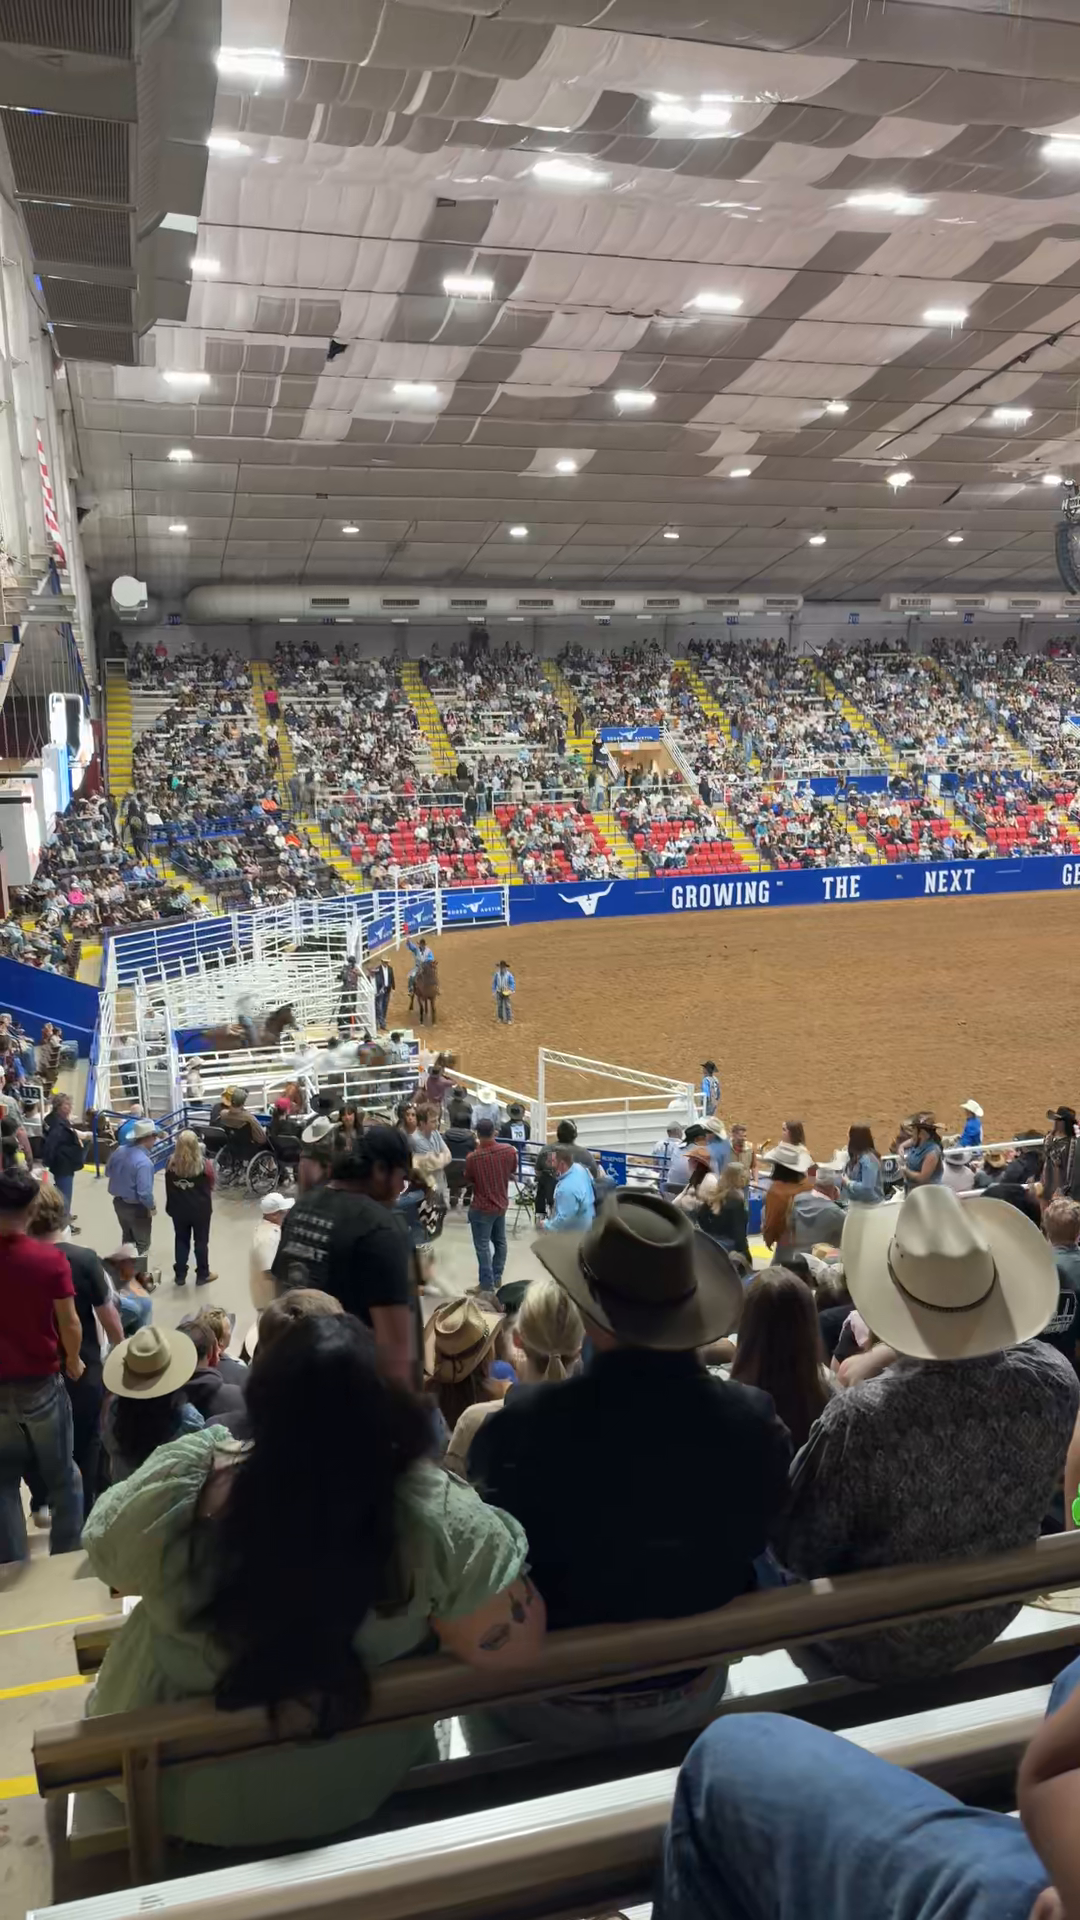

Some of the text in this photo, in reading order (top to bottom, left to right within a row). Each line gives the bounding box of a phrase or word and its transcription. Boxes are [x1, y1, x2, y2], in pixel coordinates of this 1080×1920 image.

[671, 880, 770, 909] GROWING
[822, 875, 861, 900] THE
[924, 869, 975, 893] NEXT
[23, 1087, 39, 1098] 112
